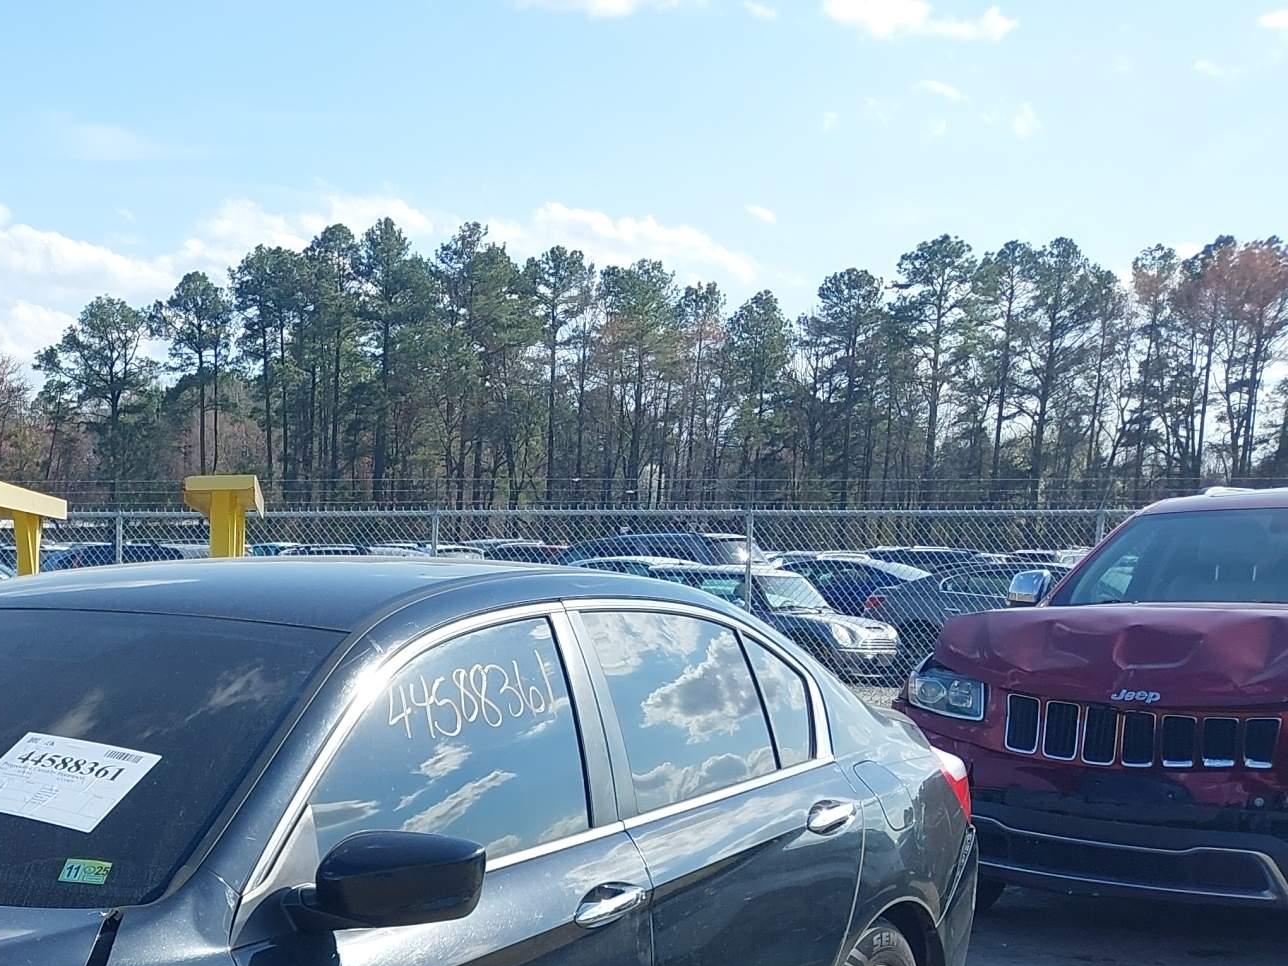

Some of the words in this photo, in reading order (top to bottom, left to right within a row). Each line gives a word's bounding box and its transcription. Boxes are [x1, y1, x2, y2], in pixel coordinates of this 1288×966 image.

[387, 649, 557, 739] 44588361
[1110, 689, 1161, 704] Jeep
[17, 750, 126, 781] 44588361
[66, 864, 82, 879] 11
[94, 866, 110, 877] 25
